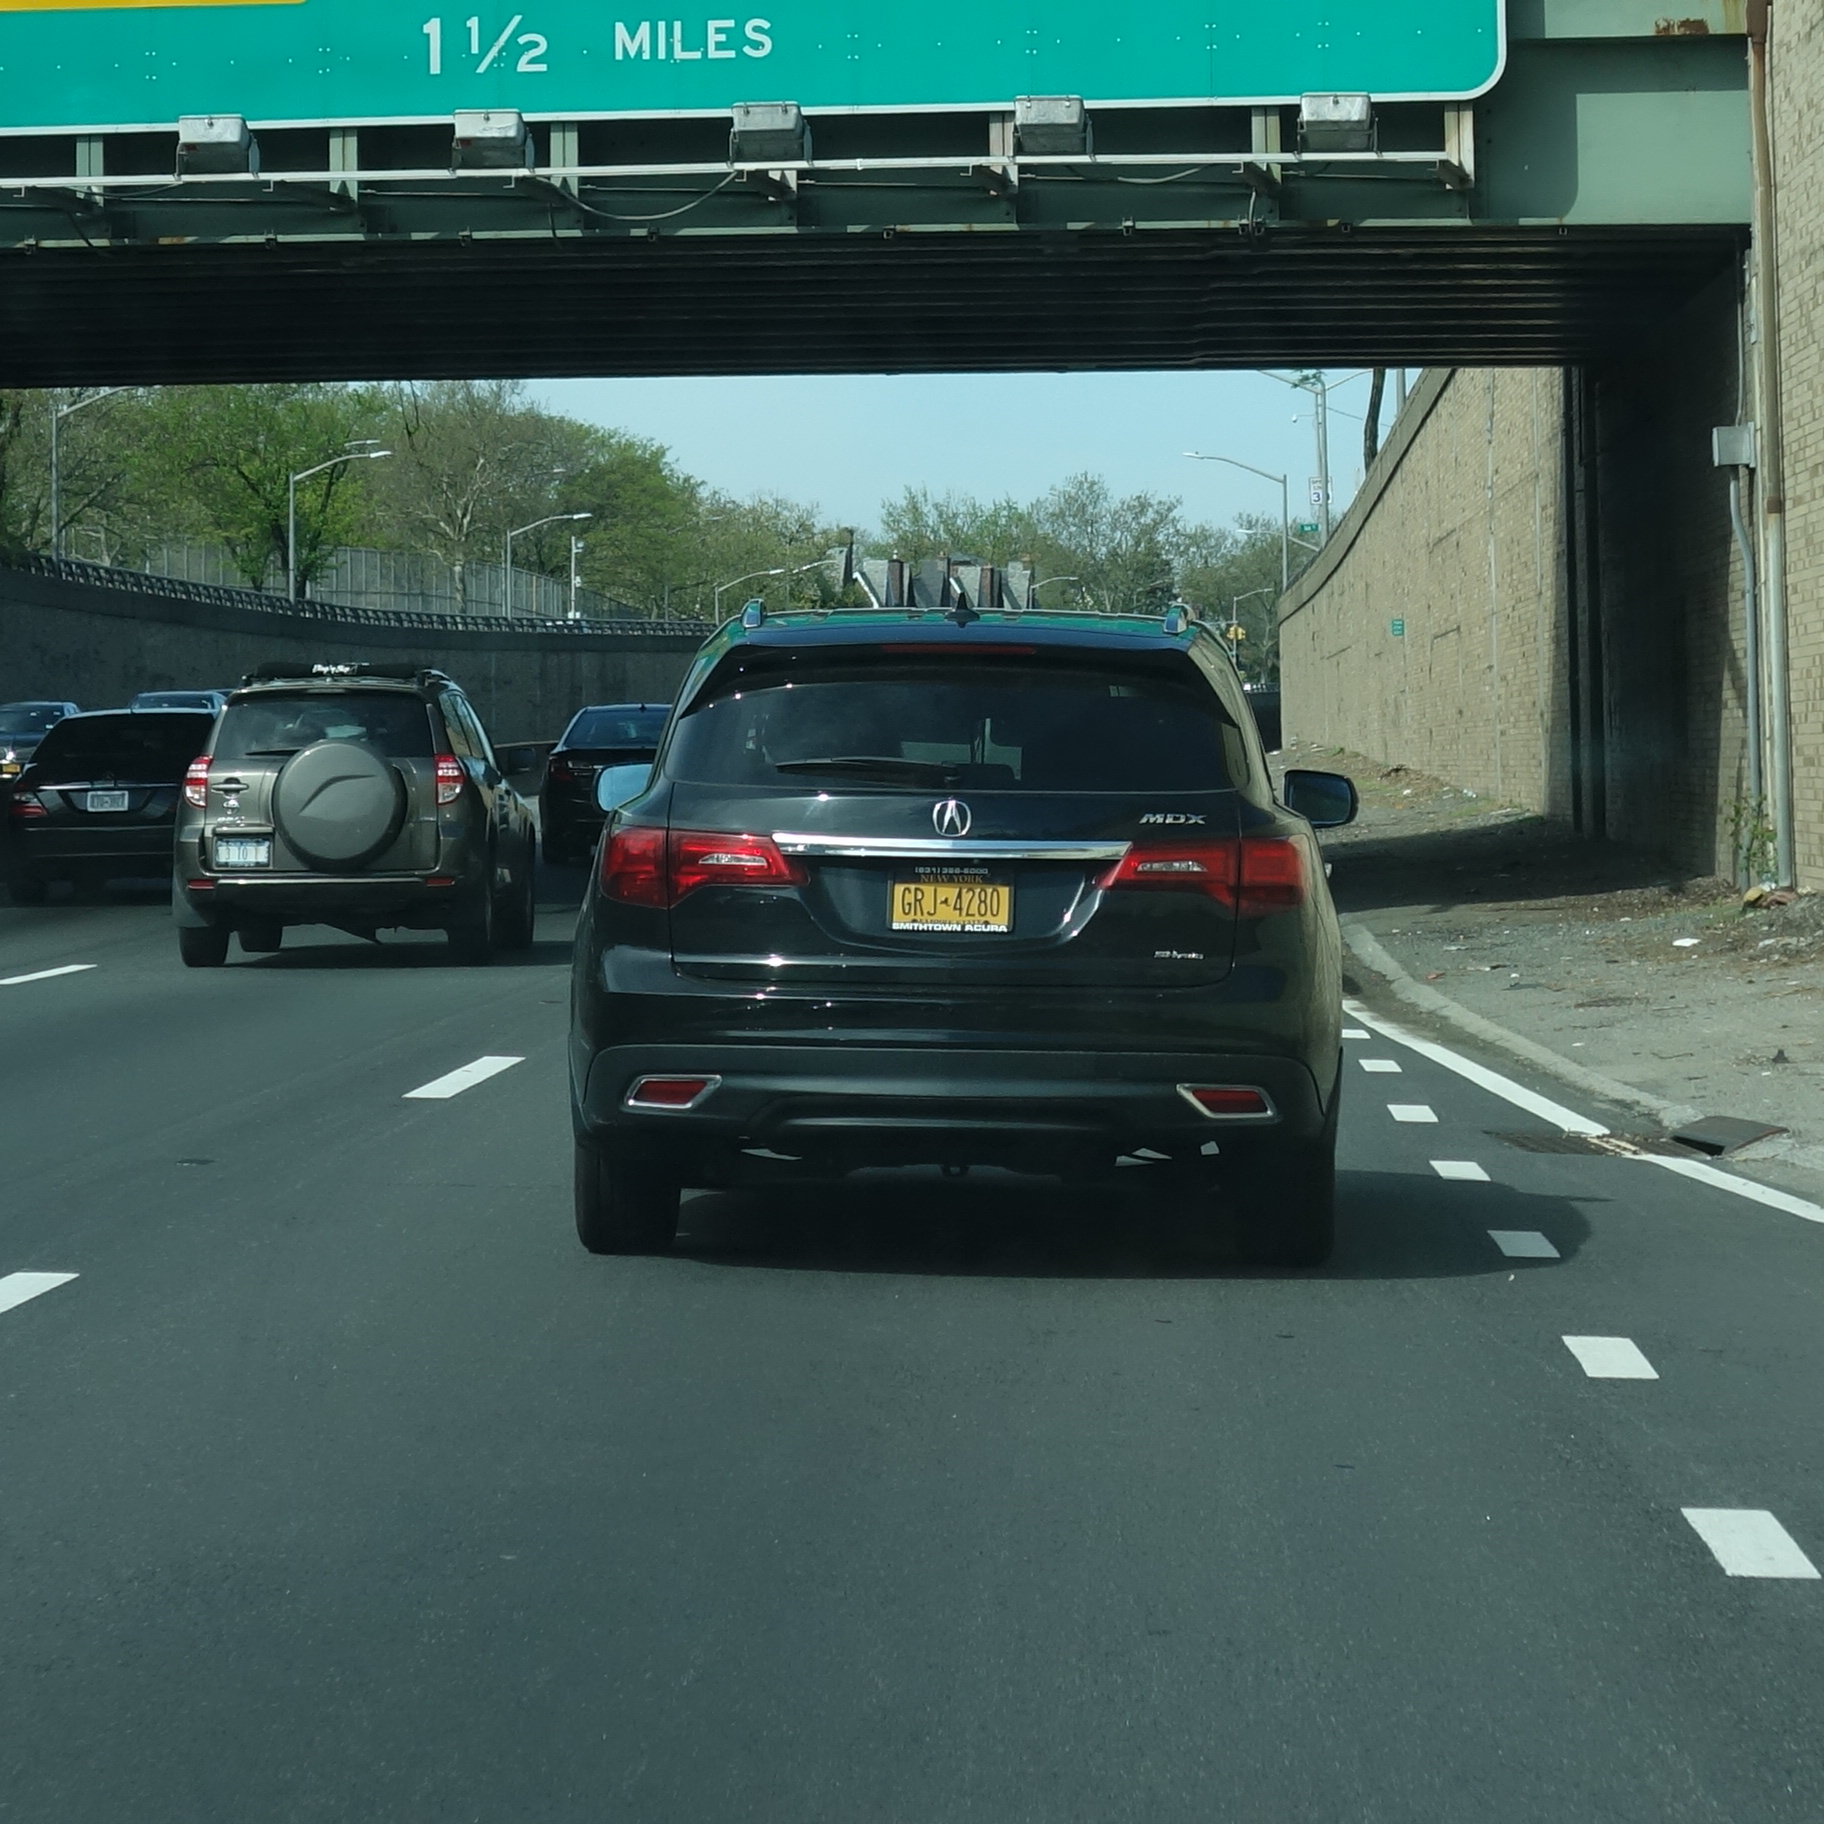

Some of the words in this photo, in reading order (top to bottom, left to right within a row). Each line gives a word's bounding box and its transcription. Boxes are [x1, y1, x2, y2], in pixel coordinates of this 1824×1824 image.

[614, 18, 773, 61] MILES
[1139, 813, 1207, 824] MDX
[920, 874, 947, 883] NEW
[953, 875, 984, 884] YORK
[892, 922, 961, 932] SMITHTOWN
[964, 923, 1008, 933] ACURA
